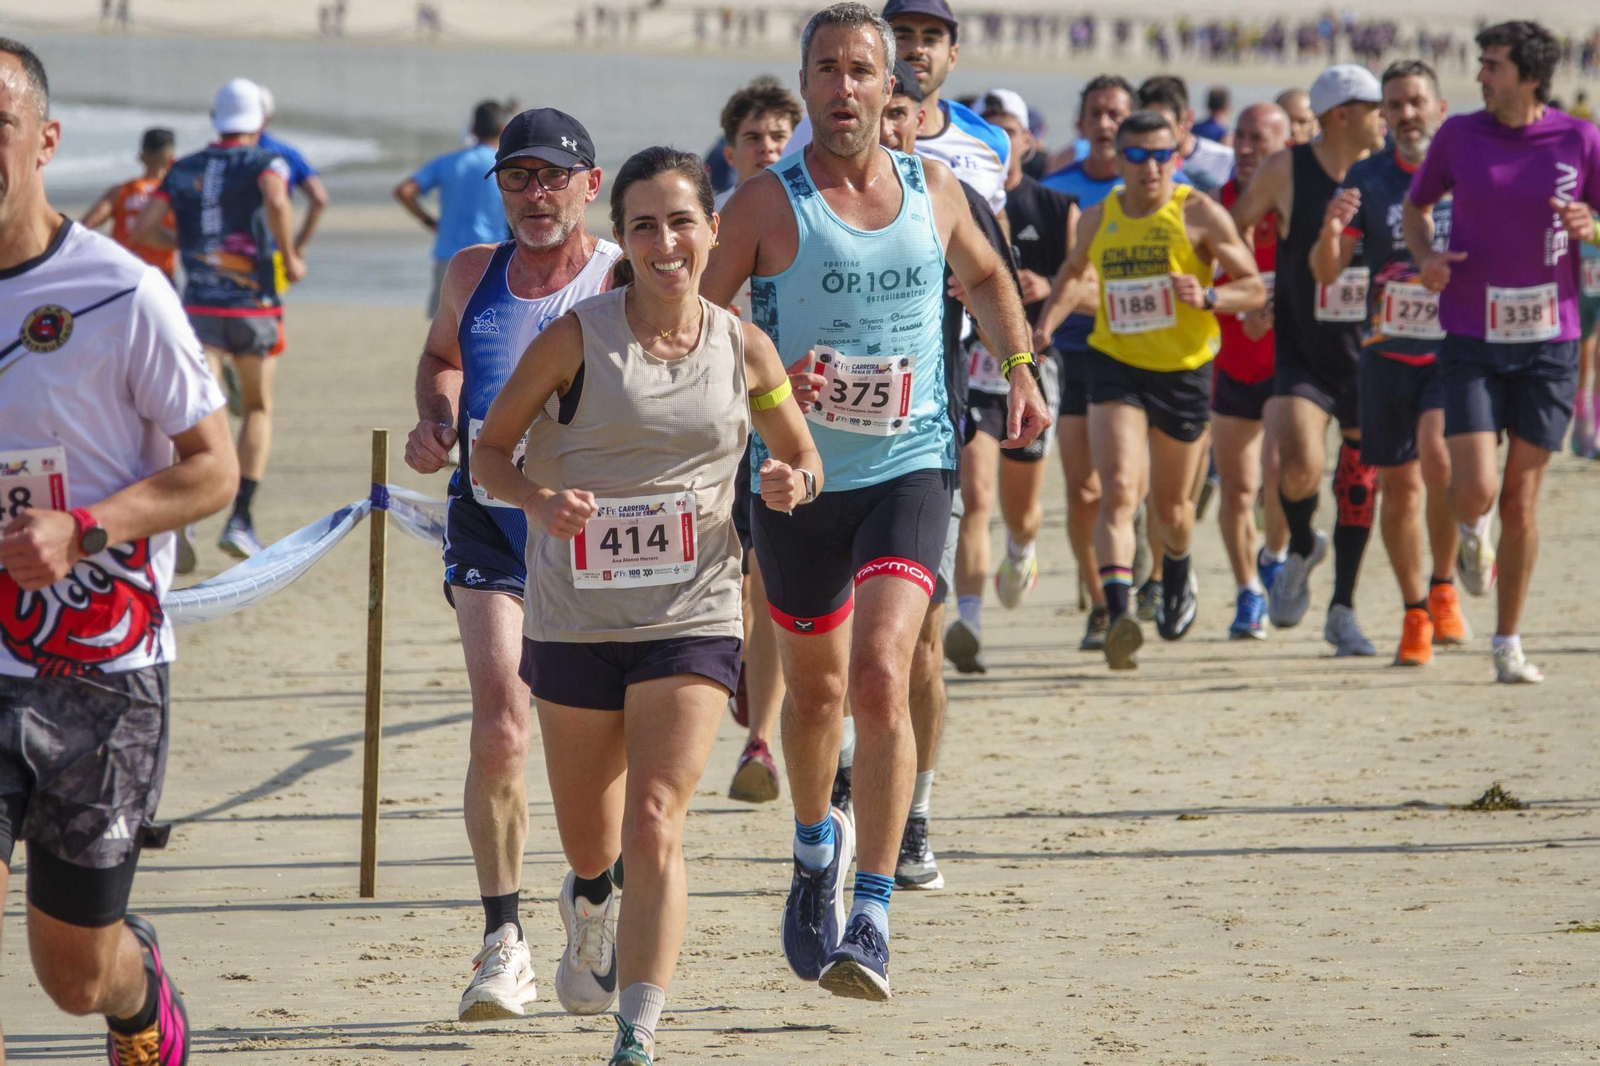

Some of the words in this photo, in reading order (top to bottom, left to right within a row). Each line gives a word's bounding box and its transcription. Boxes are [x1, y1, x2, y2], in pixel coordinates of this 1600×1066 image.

[1118, 294, 1157, 316] 188
[1399, 301, 1438, 320] 279
[1504, 304, 1543, 325] 338
[899, 321, 923, 331] MAGNA
[829, 378, 890, 408] 375
[0, 486, 33, 520] 8
[618, 504, 650, 513] CARREIRA
[600, 524, 669, 556] 414
